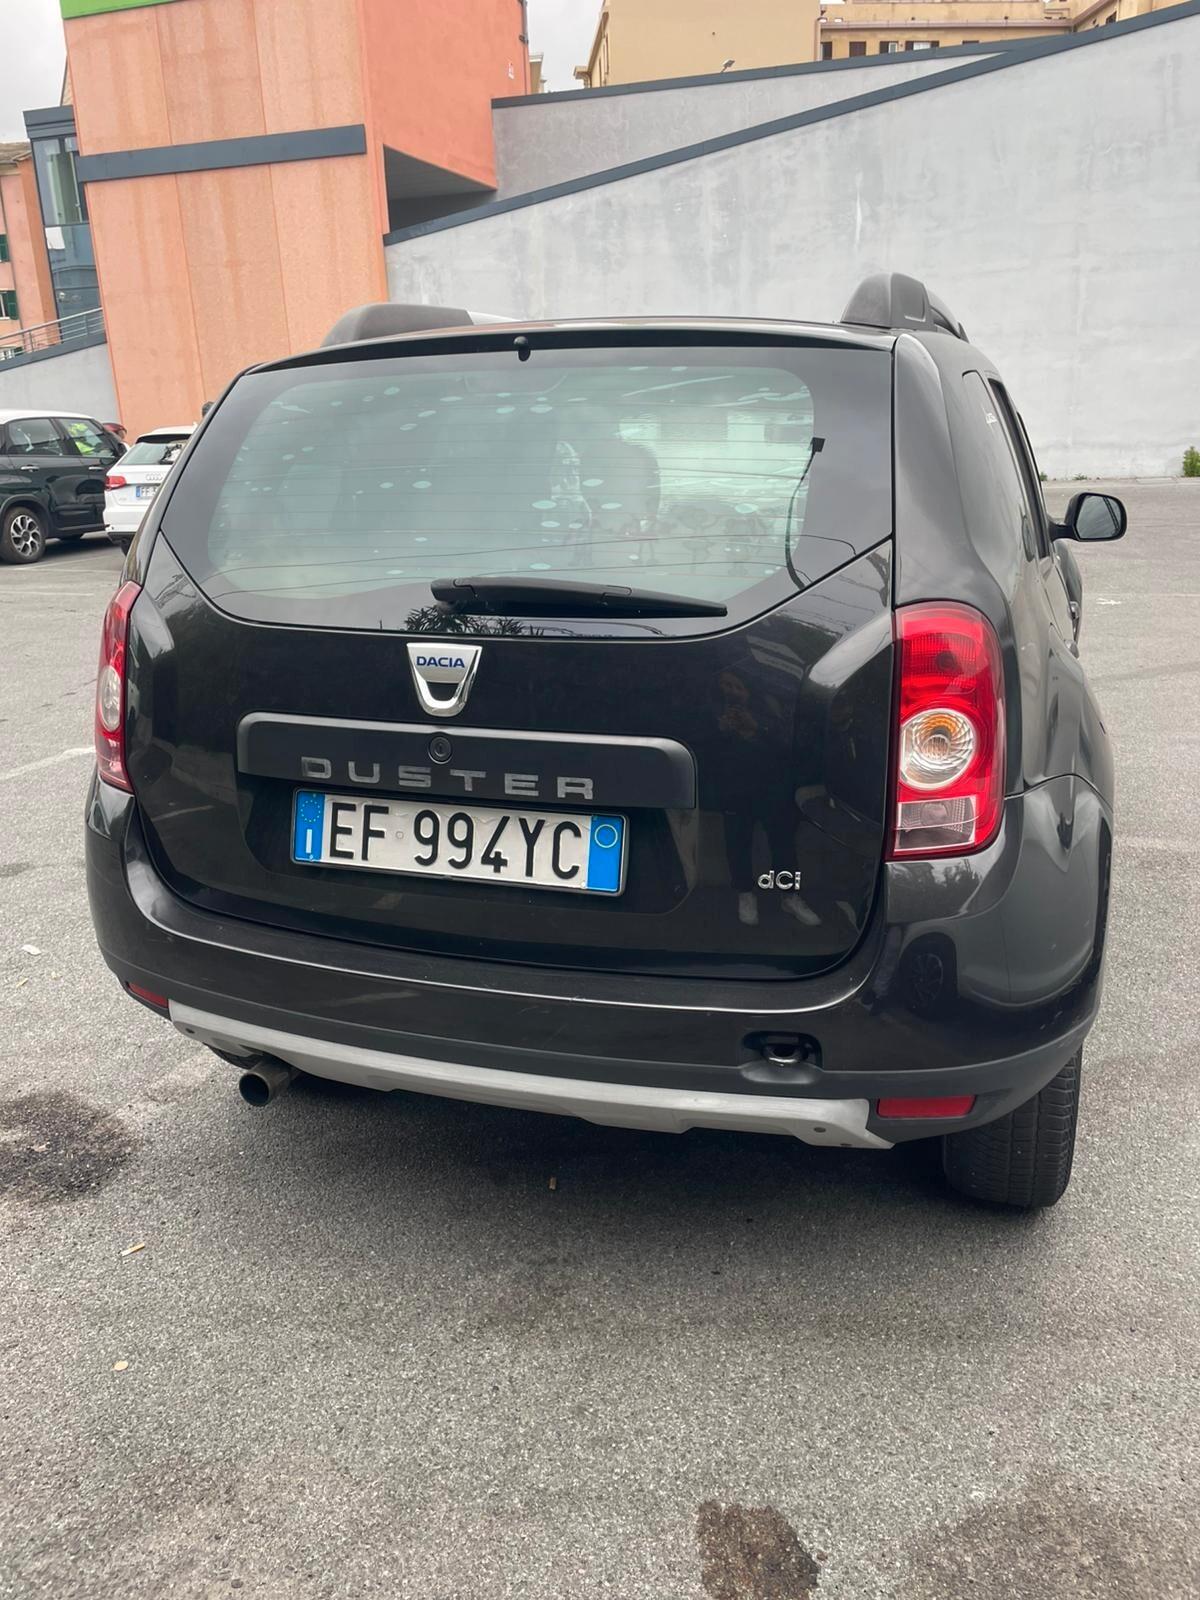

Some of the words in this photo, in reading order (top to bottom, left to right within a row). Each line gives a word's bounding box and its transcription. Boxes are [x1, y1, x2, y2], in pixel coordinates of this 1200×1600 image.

[416, 656, 465, 668] DACIA
[301, 756, 593, 800] DUSTER
[329, 802, 390, 861] EF
[413, 809, 582, 880] 994YC
[757, 870, 801, 890] dCi
